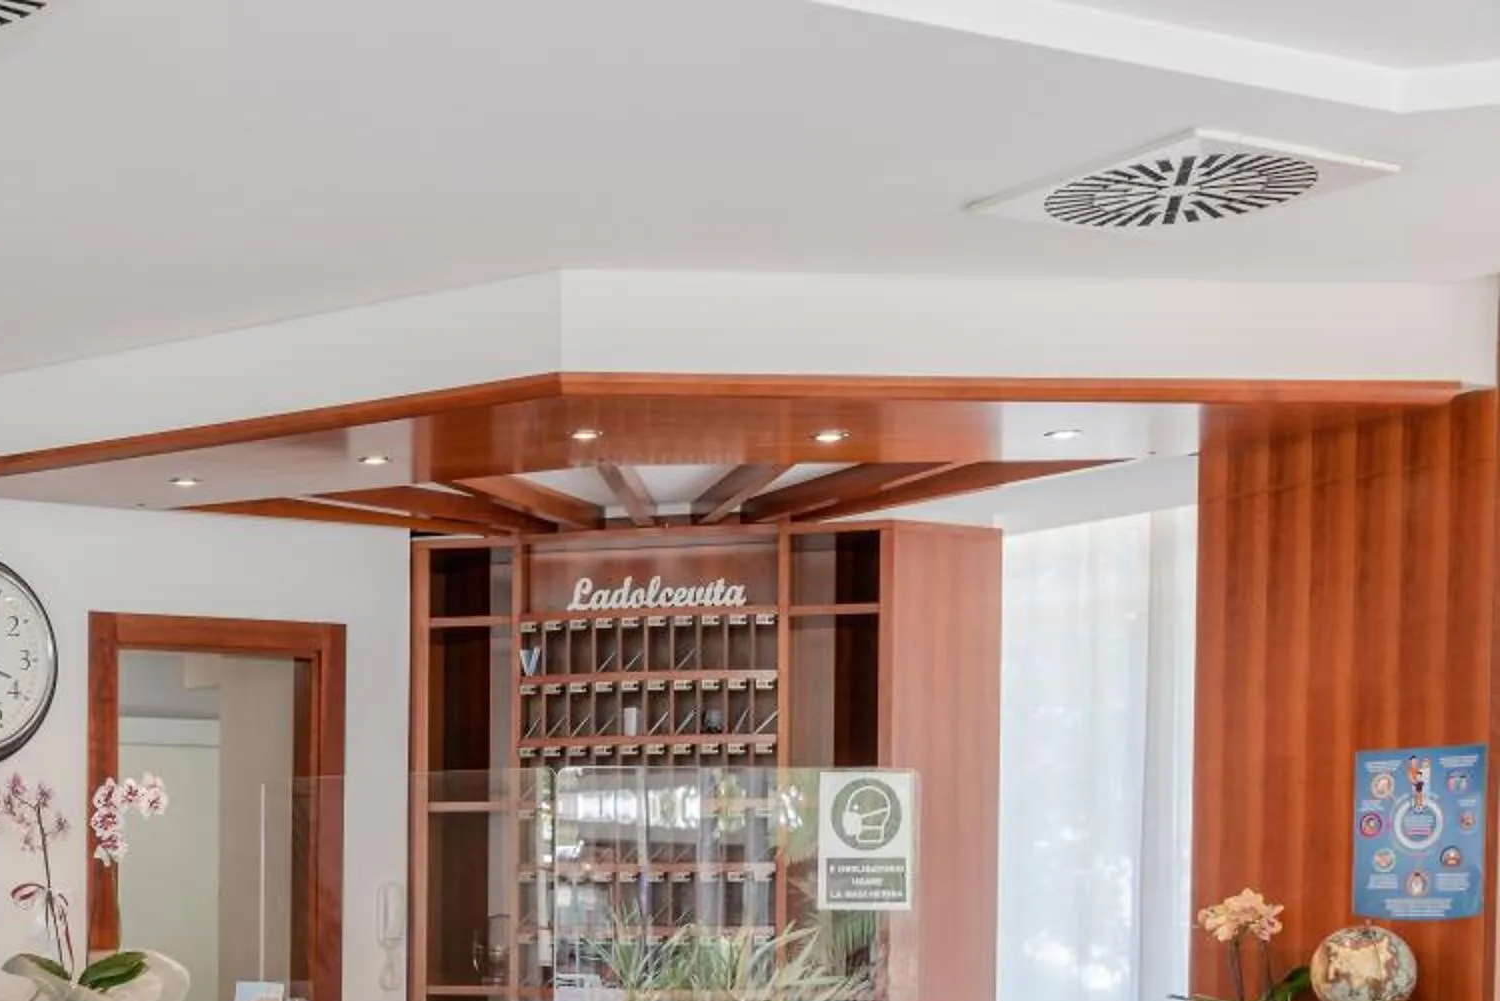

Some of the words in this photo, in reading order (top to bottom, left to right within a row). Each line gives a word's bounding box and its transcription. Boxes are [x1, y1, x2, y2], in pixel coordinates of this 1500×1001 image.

[567, 575, 747, 611] Ladolcevita
[6, 615, 20, 637] 2
[20, 650, 31, 671] 3
[7, 680, 21, 699] 4
